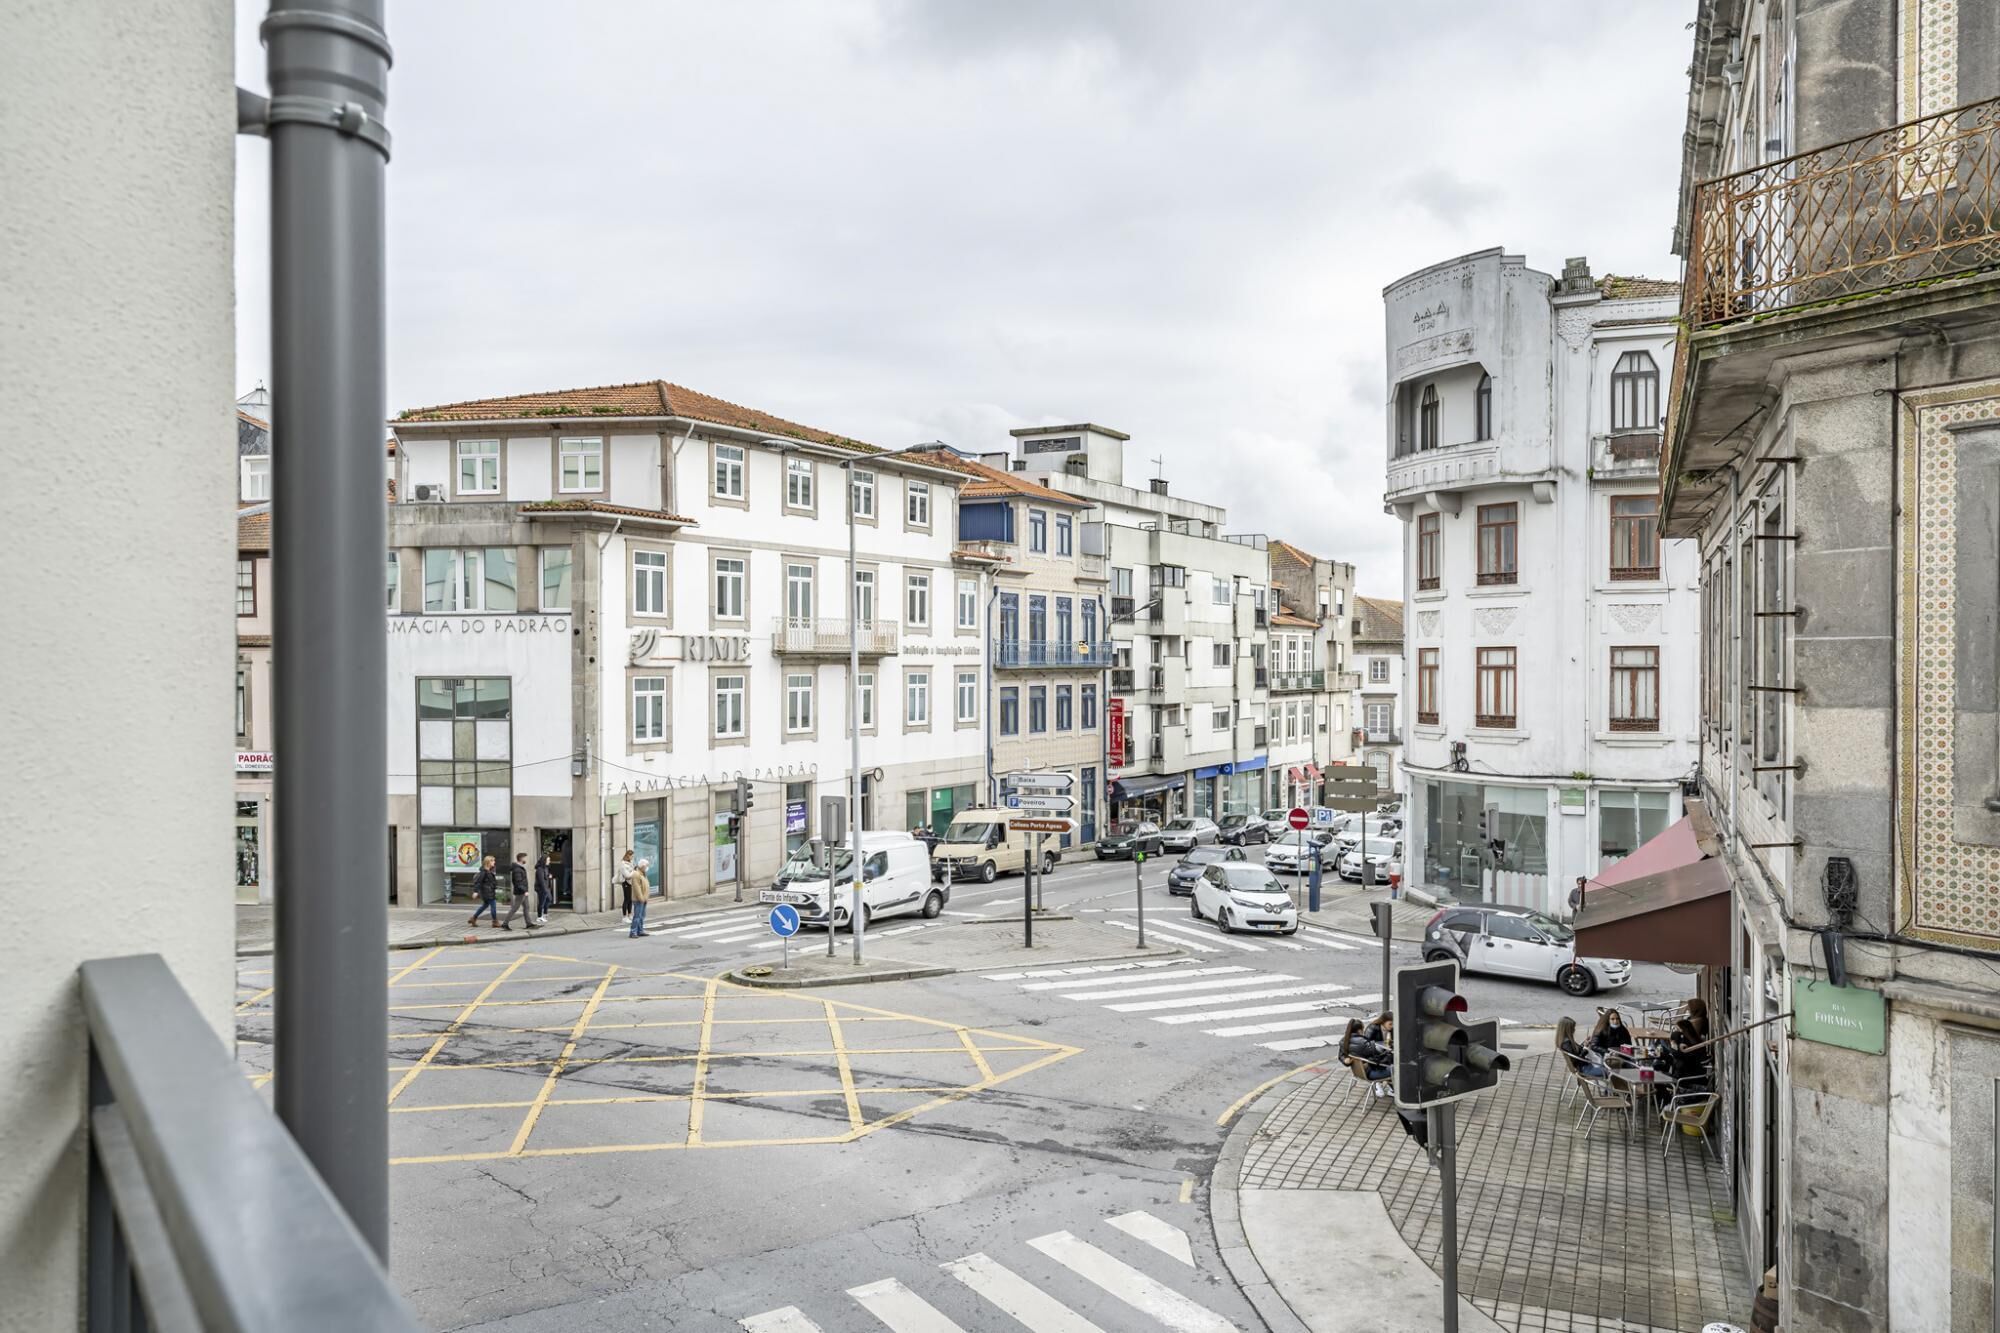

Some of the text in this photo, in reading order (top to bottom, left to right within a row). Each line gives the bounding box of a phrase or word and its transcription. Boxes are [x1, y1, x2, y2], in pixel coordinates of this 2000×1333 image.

[386, 617, 567, 634] RMÁCIA DO PADRÃO
[682, 635, 751, 662] RIME
[607, 761, 818, 795] FARMÁCIA DO PADRÃO
[1832, 1003, 1846, 1013] RUA
[1815, 1011, 1864, 1031] FORMOSA
